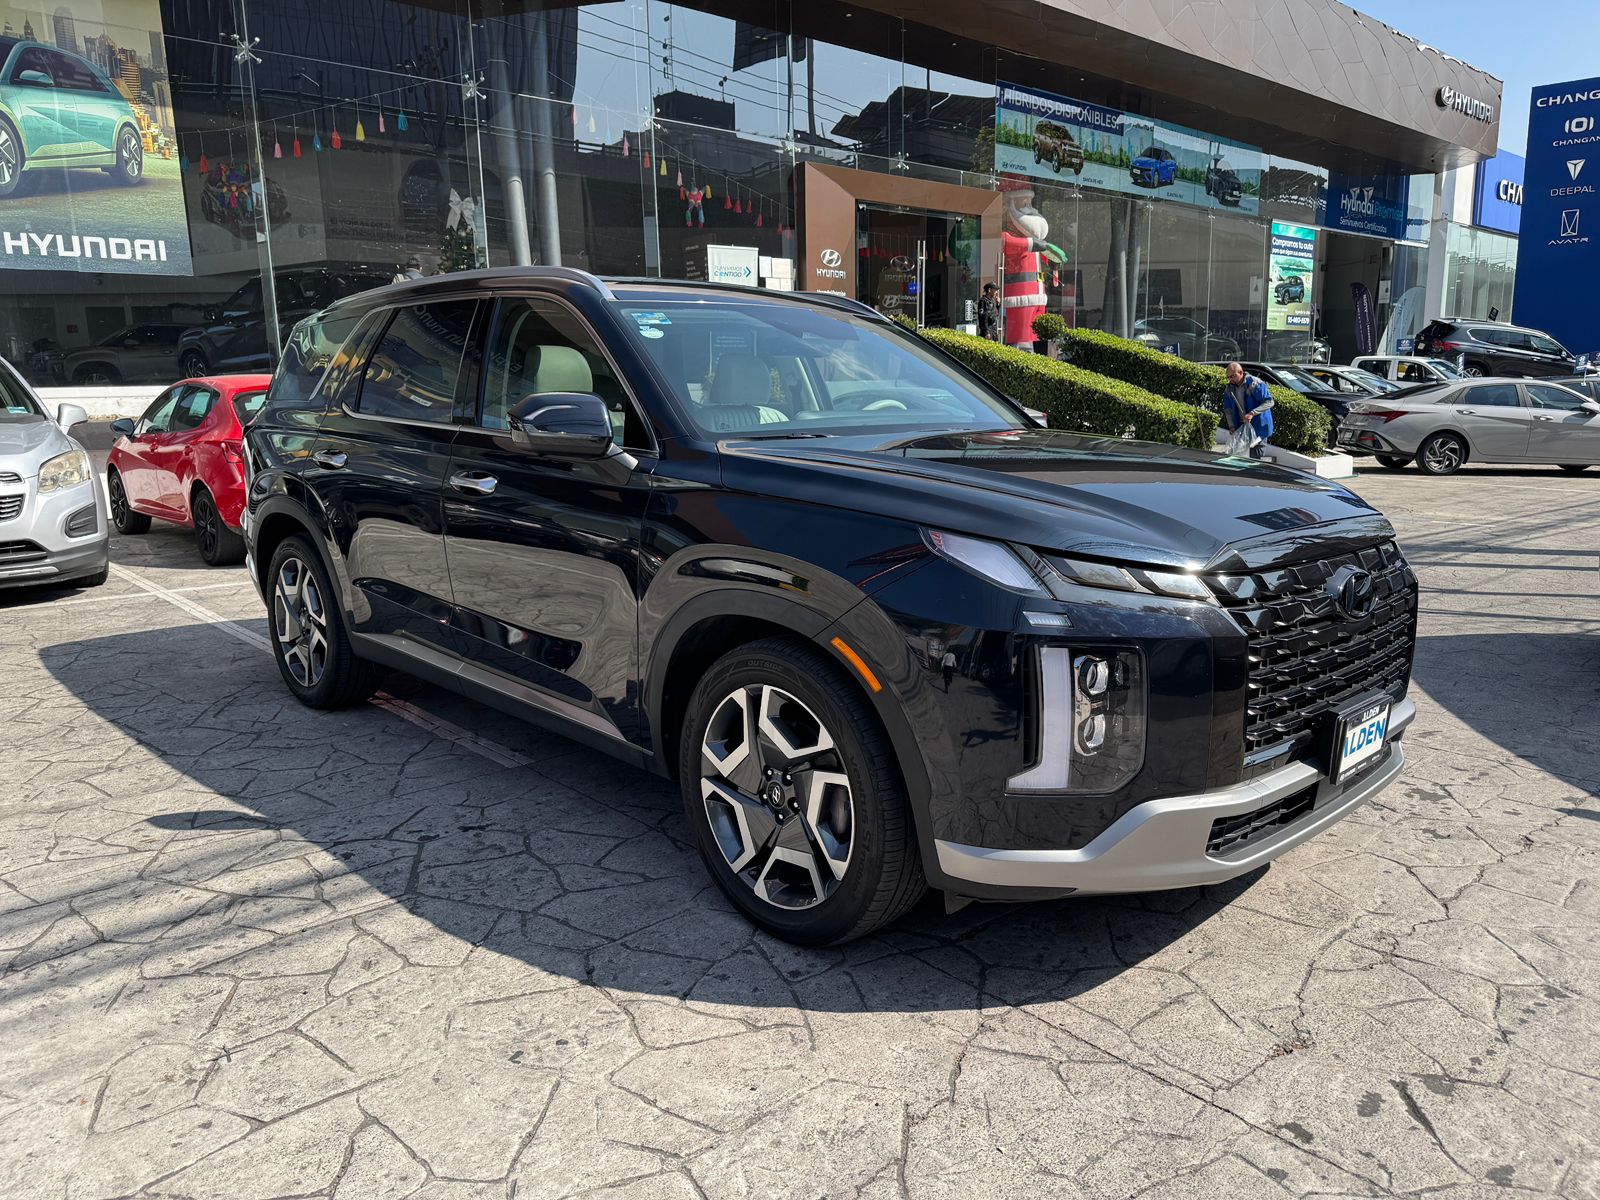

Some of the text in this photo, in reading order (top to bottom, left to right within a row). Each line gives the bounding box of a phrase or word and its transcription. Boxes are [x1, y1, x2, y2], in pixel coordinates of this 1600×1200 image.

[1454, 92, 1494, 122] HYUNDAI
[1550, 186, 1595, 197] DEEPAL
[1341, 194, 1404, 220] Hyundai Promise
[1340, 216, 1387, 233] Seminuevos Certificados
[3, 231, 167, 261] HYUNDAI
[1272, 237, 1298, 249] Compramos
[1298, 241, 1304, 249] tu
[1548, 237, 1590, 246] AVATR
[816, 267, 846, 279] HYUNDAI
